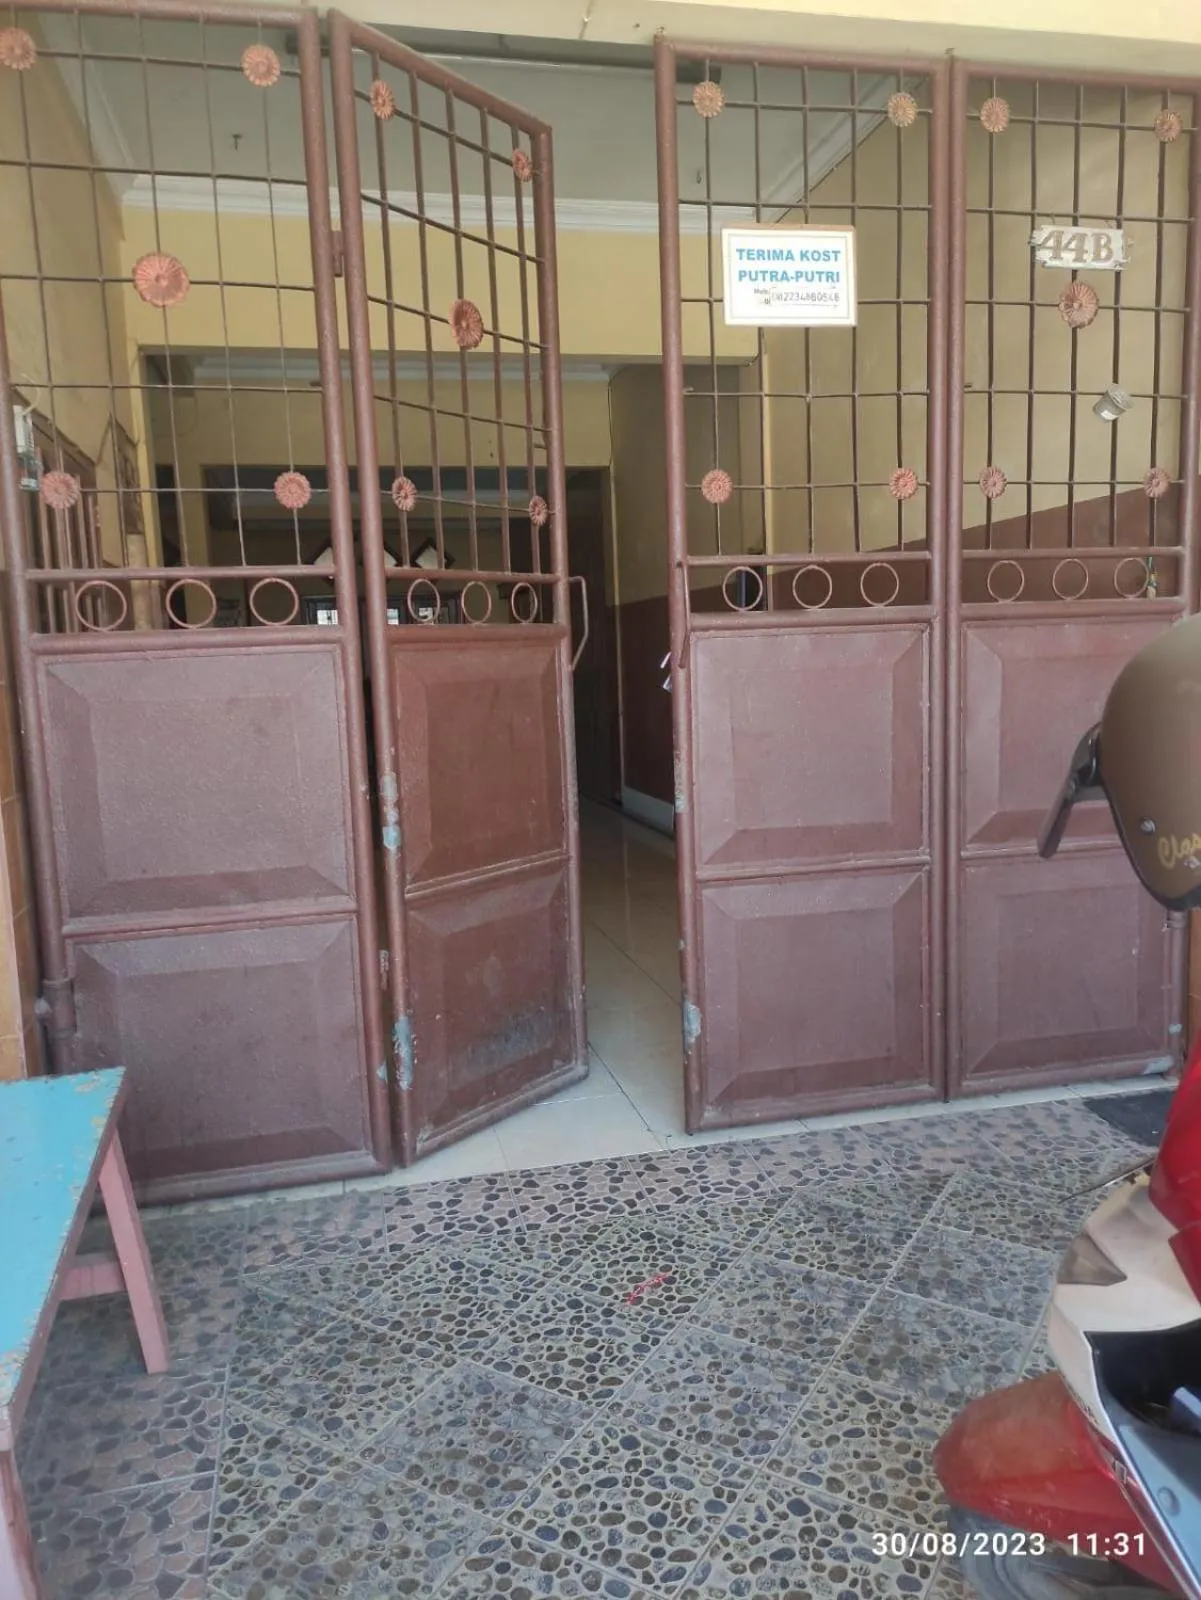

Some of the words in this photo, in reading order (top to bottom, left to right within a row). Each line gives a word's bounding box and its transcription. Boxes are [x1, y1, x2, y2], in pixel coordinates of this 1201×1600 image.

[1040, 230, 1114, 262] 44B
[736, 248, 795, 261] TERIMA
[800, 249, 841, 261] KOST
[738, 269, 840, 283] PUTRA-PUTRI
